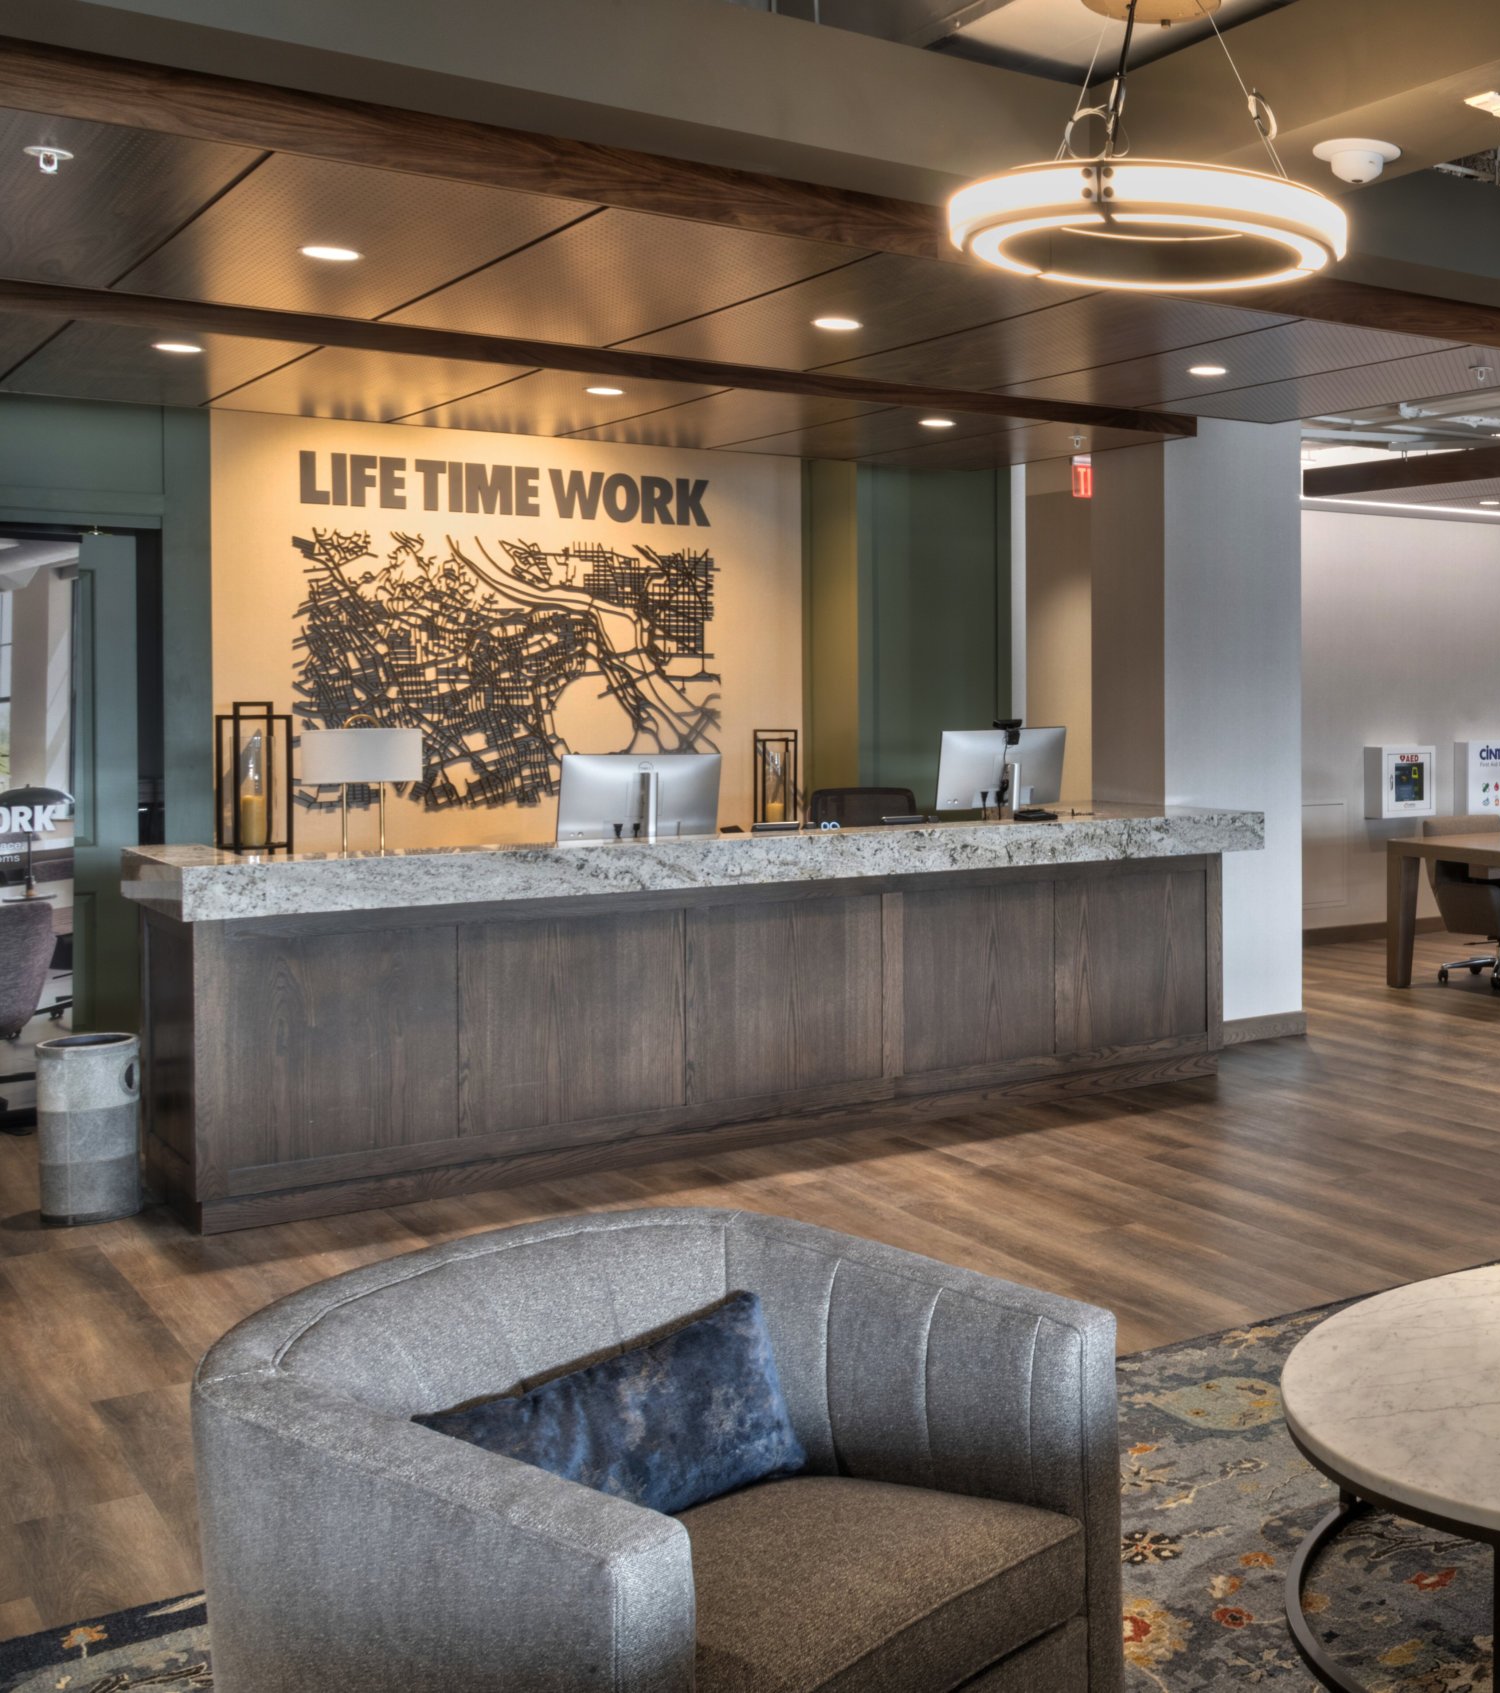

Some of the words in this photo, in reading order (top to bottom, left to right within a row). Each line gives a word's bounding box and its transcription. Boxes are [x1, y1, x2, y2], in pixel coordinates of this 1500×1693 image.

[299, 450, 407, 510] LIFE
[415, 459, 540, 517] TIME
[549, 468, 711, 527] WORK
[1405, 754, 1419, 762] AED
